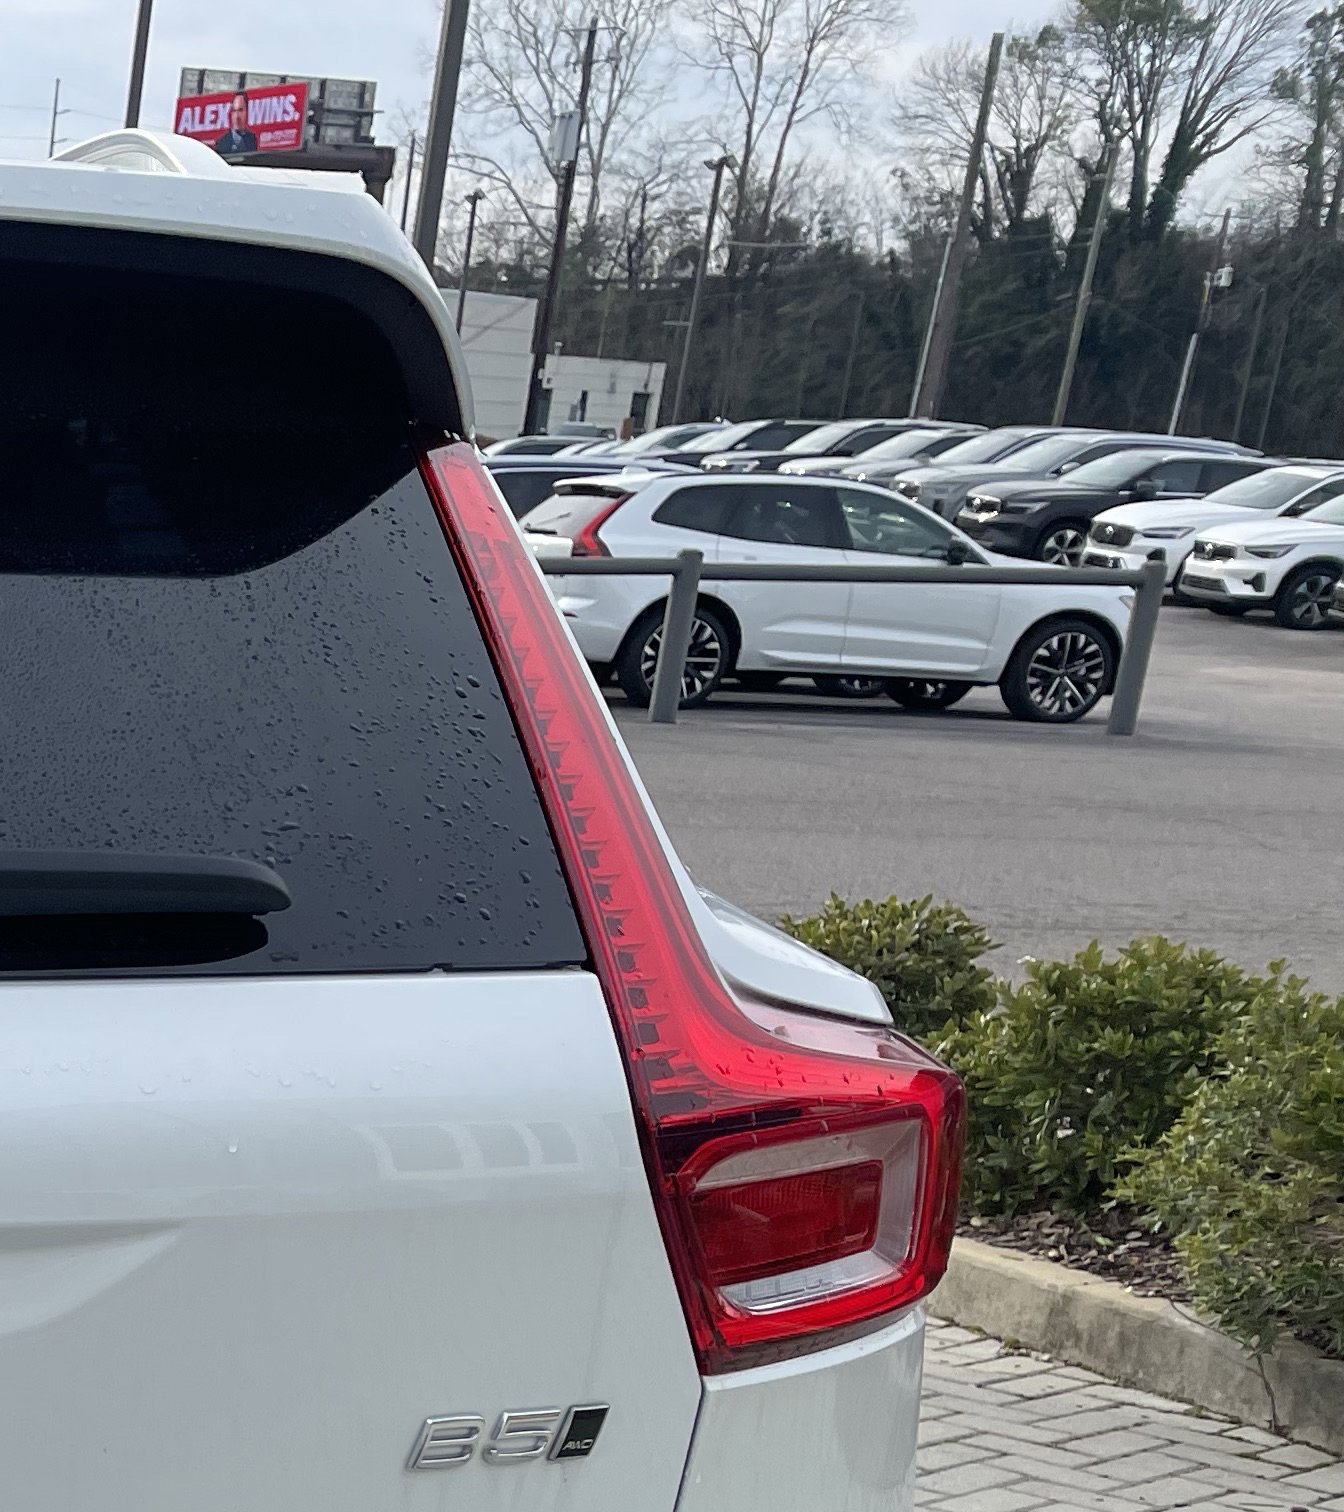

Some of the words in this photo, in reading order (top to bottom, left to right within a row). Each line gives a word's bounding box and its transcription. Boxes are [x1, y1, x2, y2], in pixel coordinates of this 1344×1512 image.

[178, 102, 231, 133] ALEX
[247, 94, 300, 126] WINS.
[407, 1407, 561, 1471] B5
